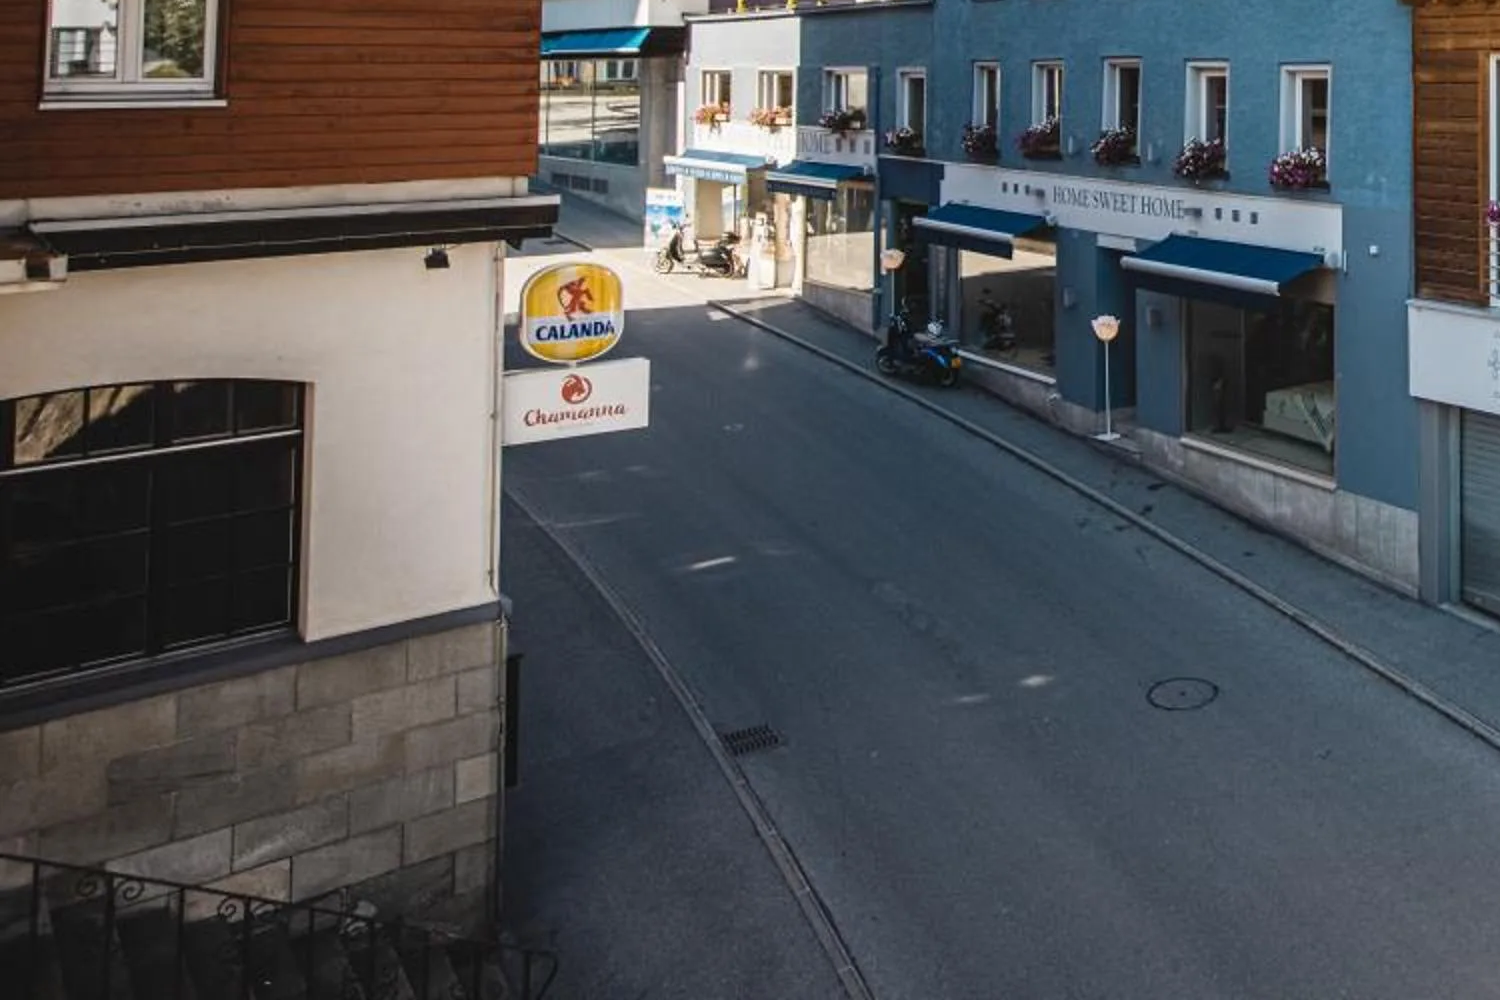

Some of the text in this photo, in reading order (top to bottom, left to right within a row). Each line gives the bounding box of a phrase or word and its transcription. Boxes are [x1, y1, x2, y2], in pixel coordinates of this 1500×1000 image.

[1053, 185, 1184, 219] HOME SWEET HOME
[535, 319, 615, 341] CALANDA
[523, 403, 627, 427] Chamanna
